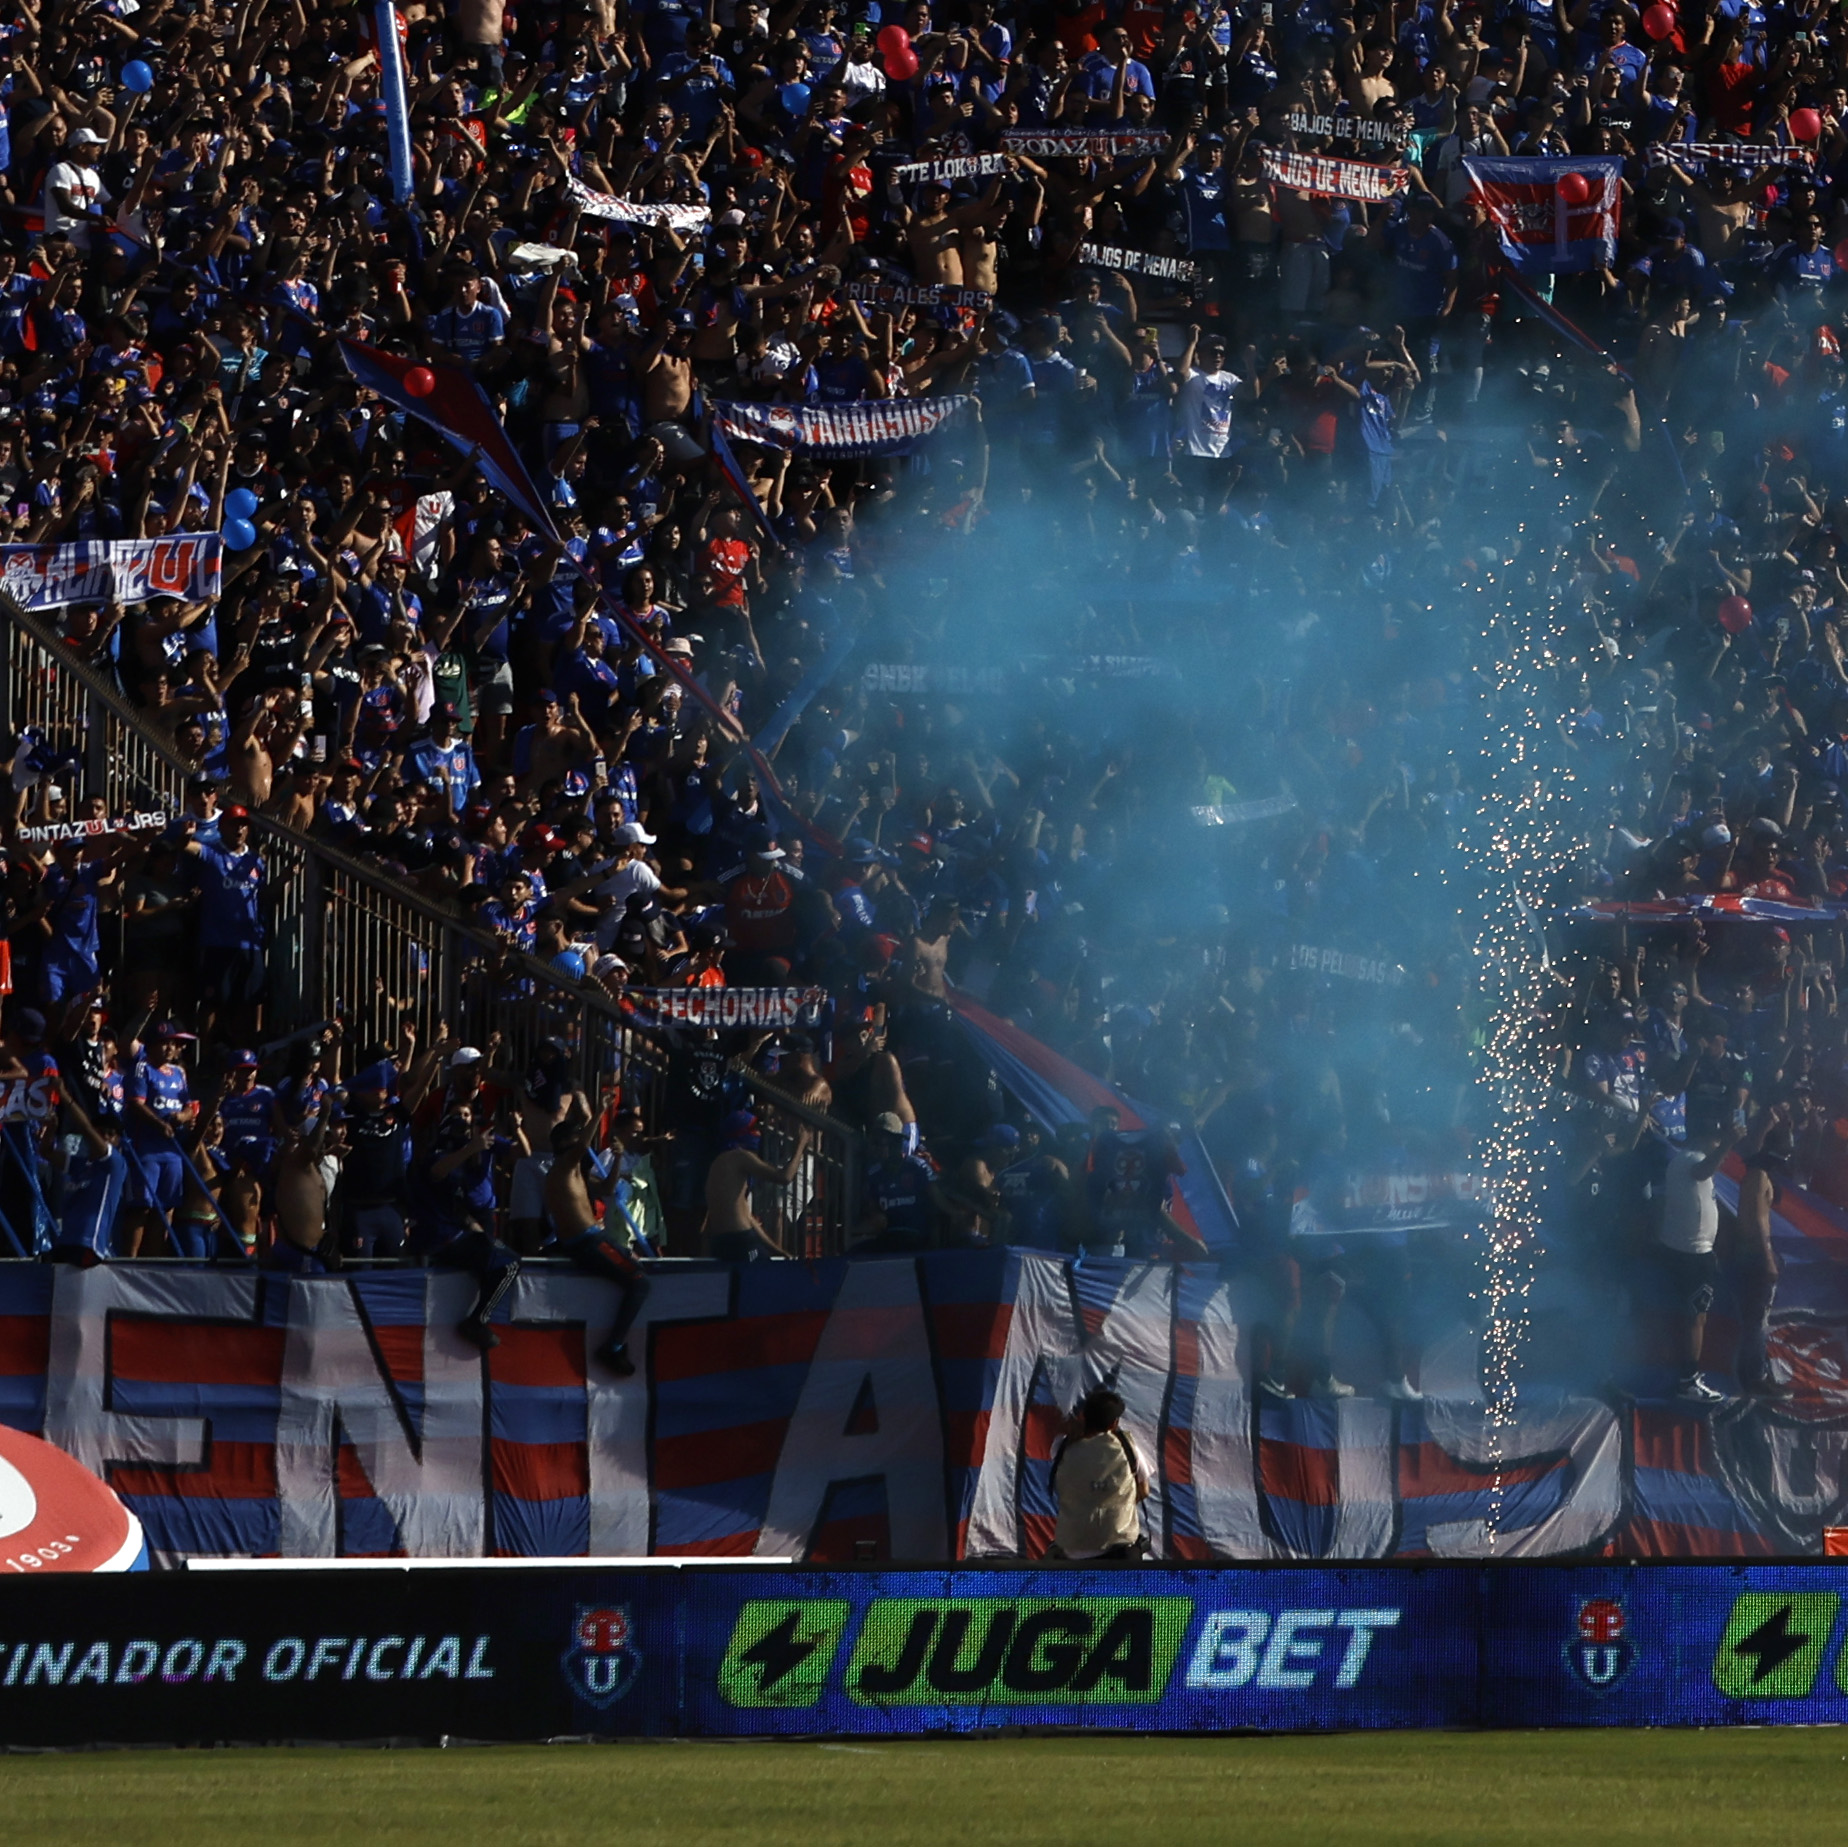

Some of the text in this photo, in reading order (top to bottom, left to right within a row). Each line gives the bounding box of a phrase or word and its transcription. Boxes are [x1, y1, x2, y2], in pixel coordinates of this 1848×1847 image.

[1290, 112, 1391, 142] BAJOS DE MENA
[1261, 149, 1381, 199] BAJOS DE MENA
[1081, 243, 1178, 278] BAJOS DE MENA
[951, 290, 990, 307] JRS
[20, 810, 166, 841] PINTAZUL JRS
[657, 987, 799, 1026] FECHORIAS
[263, 1633, 495, 1682] OFICIAL
[862, 1607, 1402, 1695] JUGA BET
